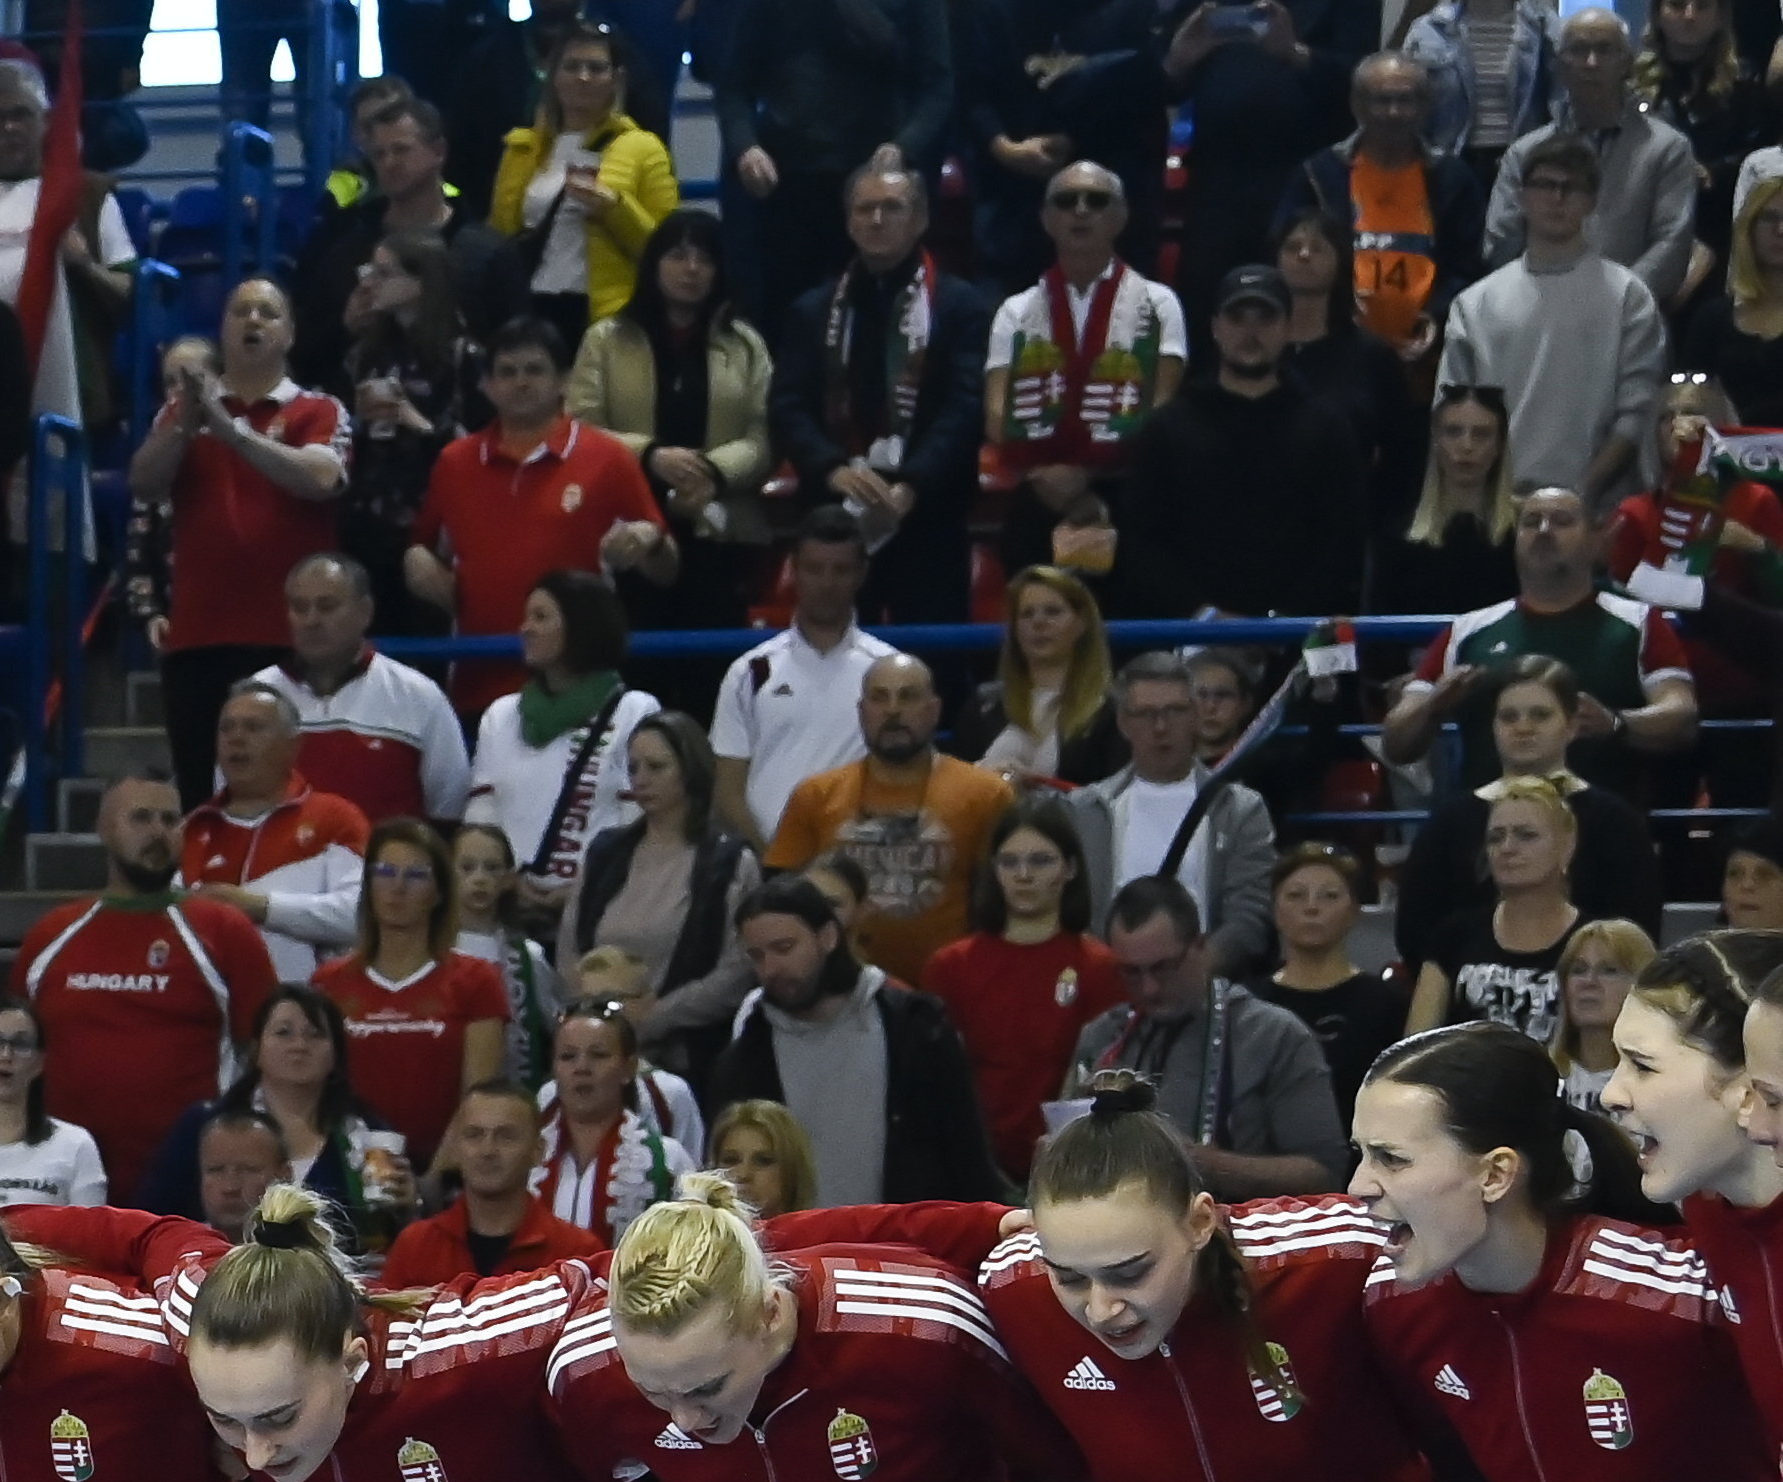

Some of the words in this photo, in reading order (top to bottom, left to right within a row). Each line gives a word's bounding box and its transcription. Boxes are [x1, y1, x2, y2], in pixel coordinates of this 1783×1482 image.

[65, 973, 170, 993] HUNGARY
[1062, 1377, 1117, 1392] adidas
[654, 1436, 704, 1451] adidas
